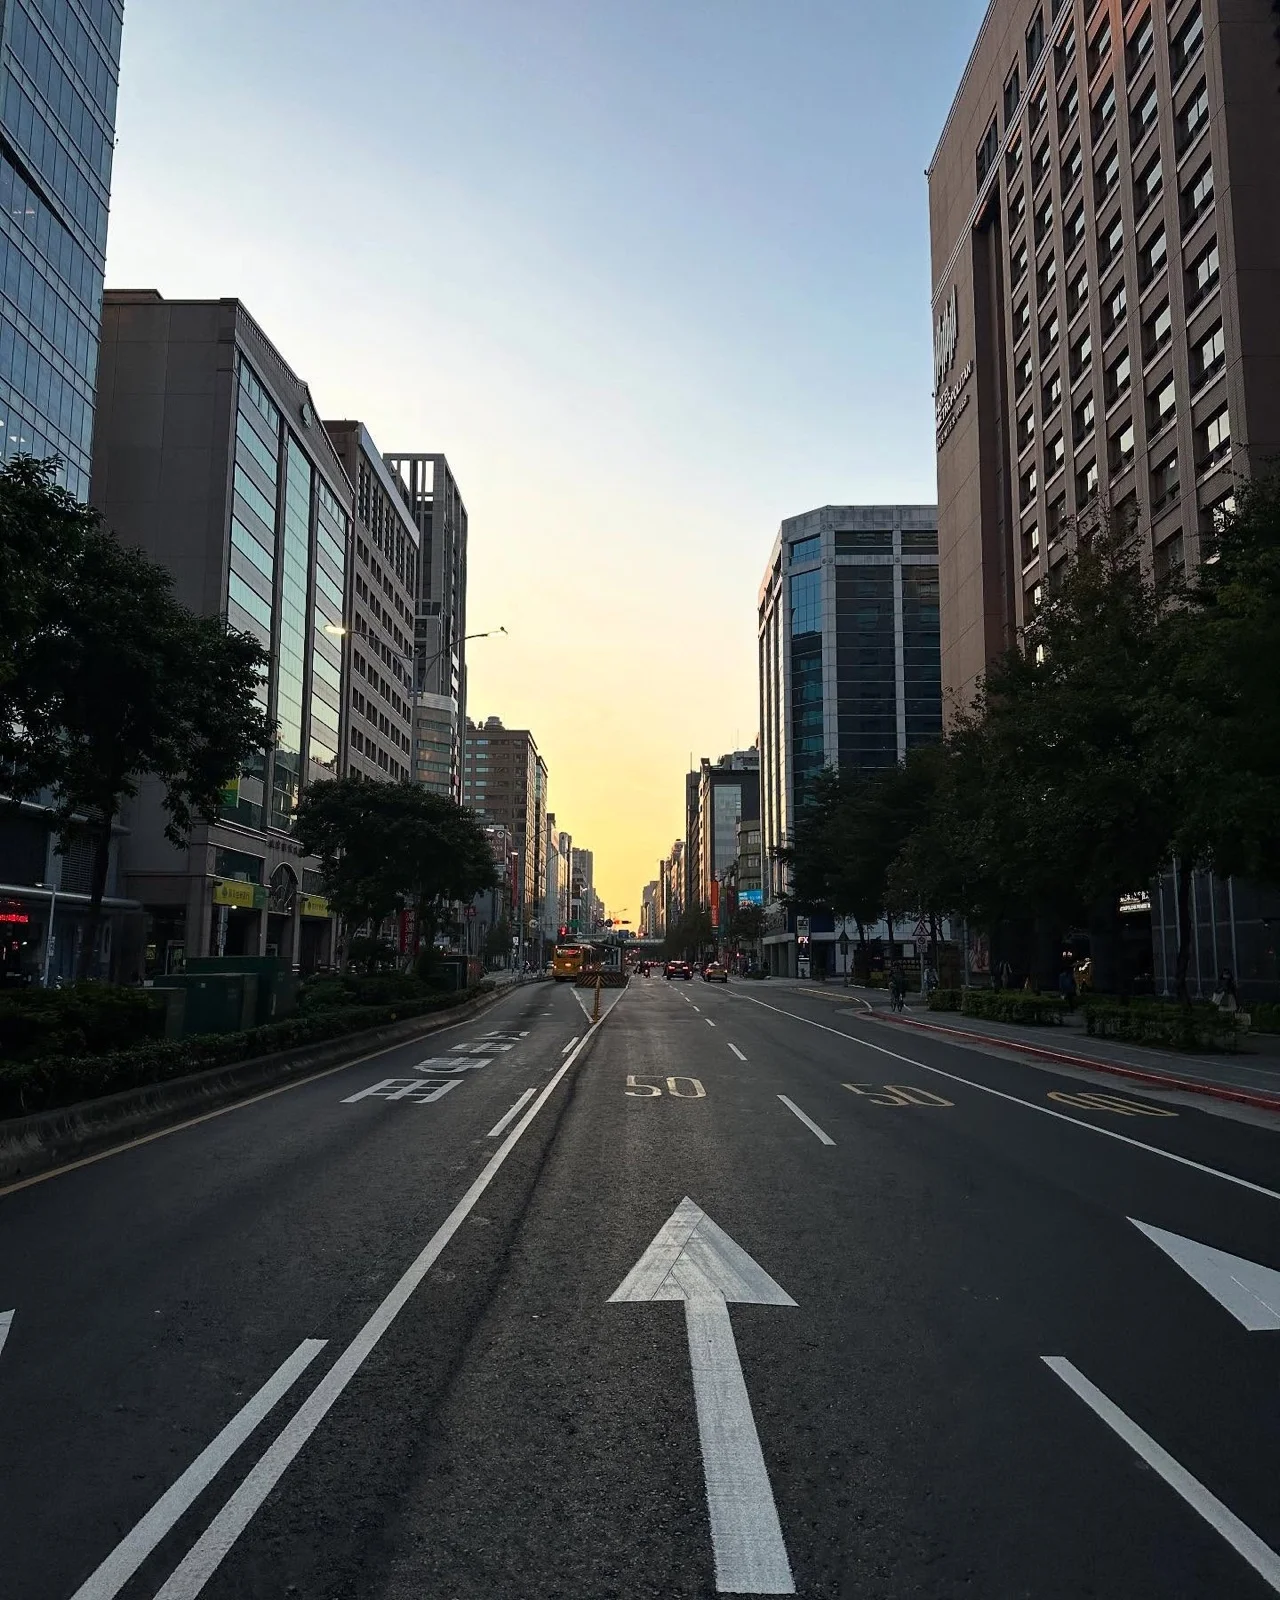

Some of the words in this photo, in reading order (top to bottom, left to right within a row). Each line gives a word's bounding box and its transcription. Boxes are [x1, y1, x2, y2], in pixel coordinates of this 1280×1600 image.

[936, 360, 971, 432] METROPOLITAN
[340, 1030, 531, 1104] 公車專用
[624, 1075, 708, 1098] 50
[841, 1082, 956, 1107] 50
[1046, 1091, 1179, 1116] 40
